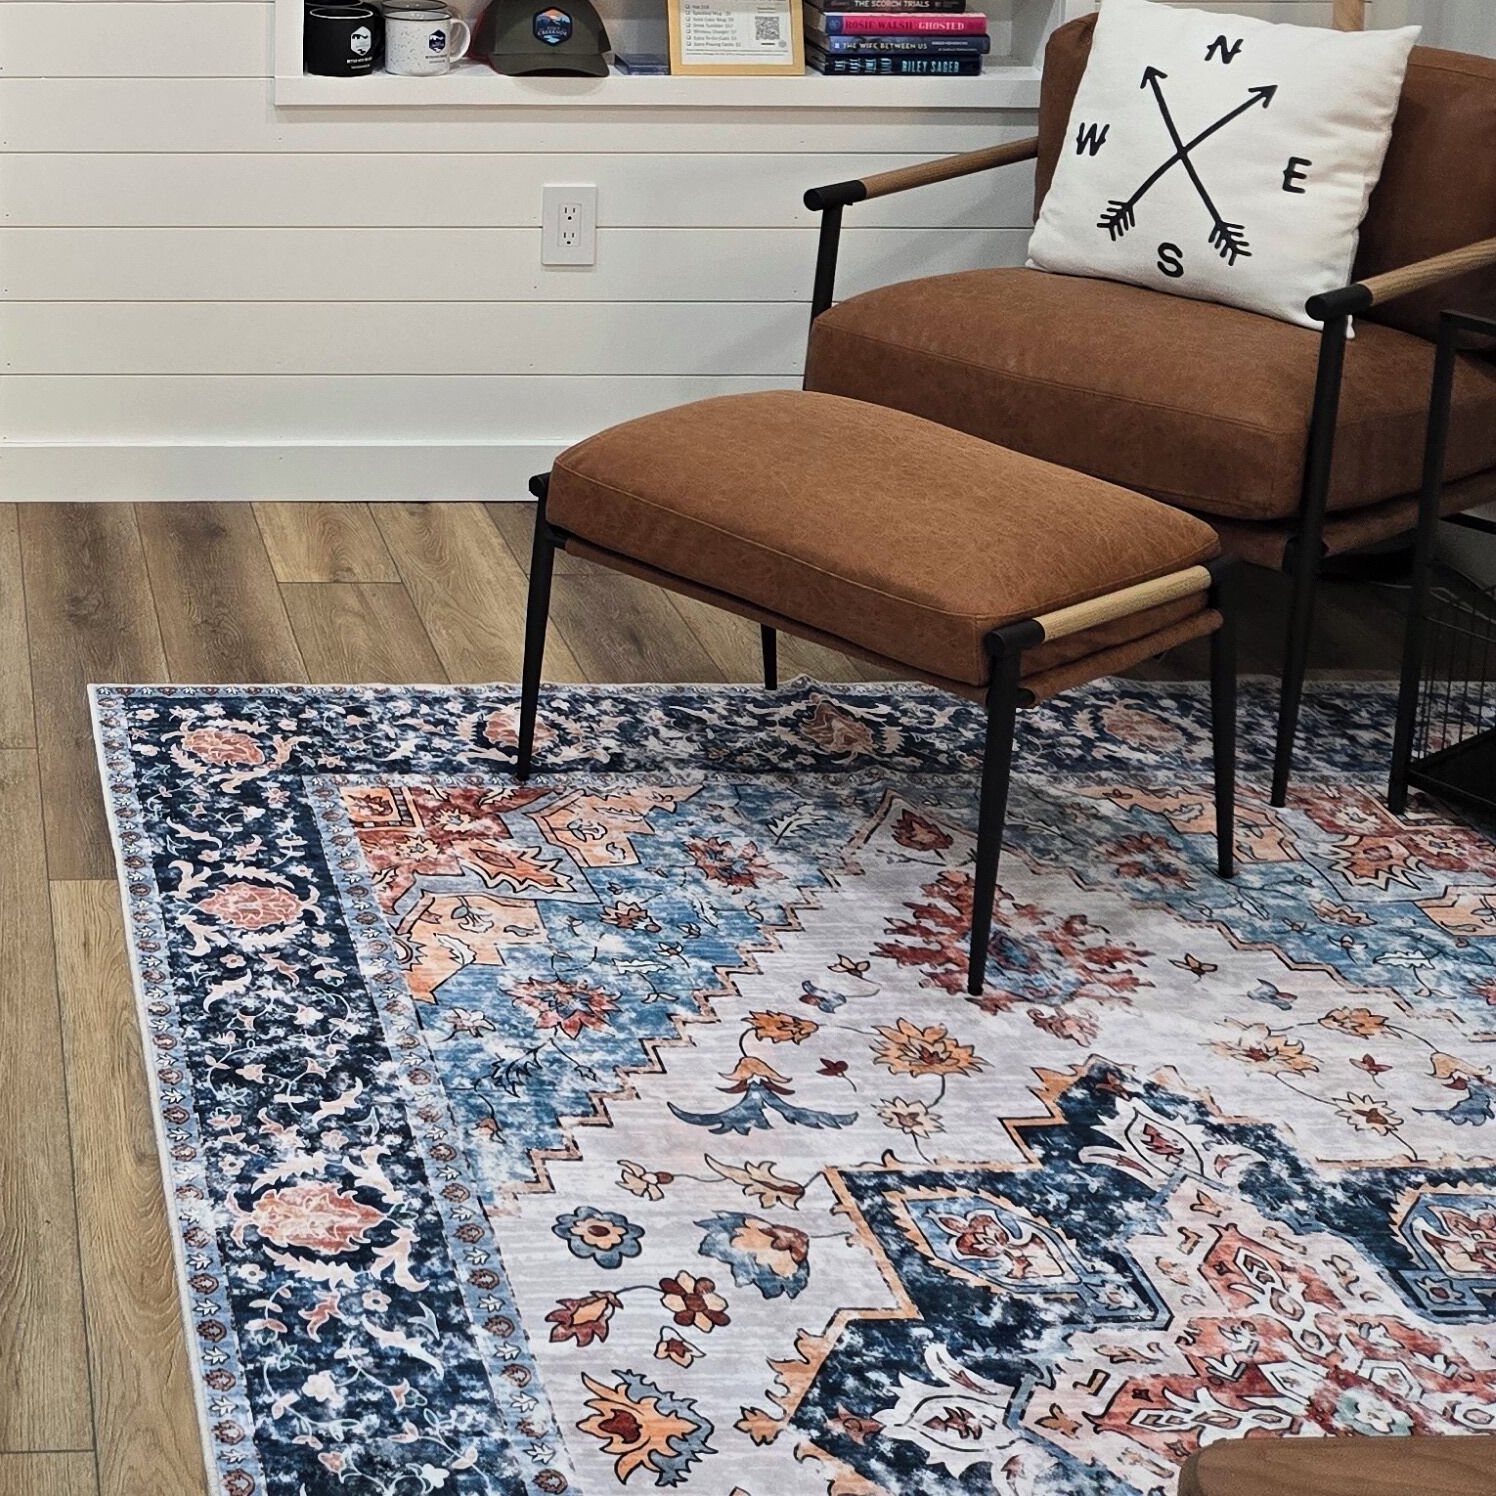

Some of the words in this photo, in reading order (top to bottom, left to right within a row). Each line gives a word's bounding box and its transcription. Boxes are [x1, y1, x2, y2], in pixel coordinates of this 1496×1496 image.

[855, 0, 870, 8] THE
[871, 0, 901, 8] SCORCH
[904, 0, 930, 8] TRIALS
[845, 20, 875, 30] ROSIE
[878, 20, 913, 30] WALSH
[918, 21, 965, 31] GHOSTED
[842, 42, 857, 50] THE
[858, 42, 879, 50] WIFE
[880, 42, 917, 50] BETWEEN
[917, 42, 928, 50] US
[1204, 34, 1244, 64] N
[901, 60, 929, 73] RILEY
[930, 61, 960, 73] SAGER
[1075, 122, 1110, 156] W
[1282, 156, 1312, 194] E
[1157, 242, 1185, 278] S
